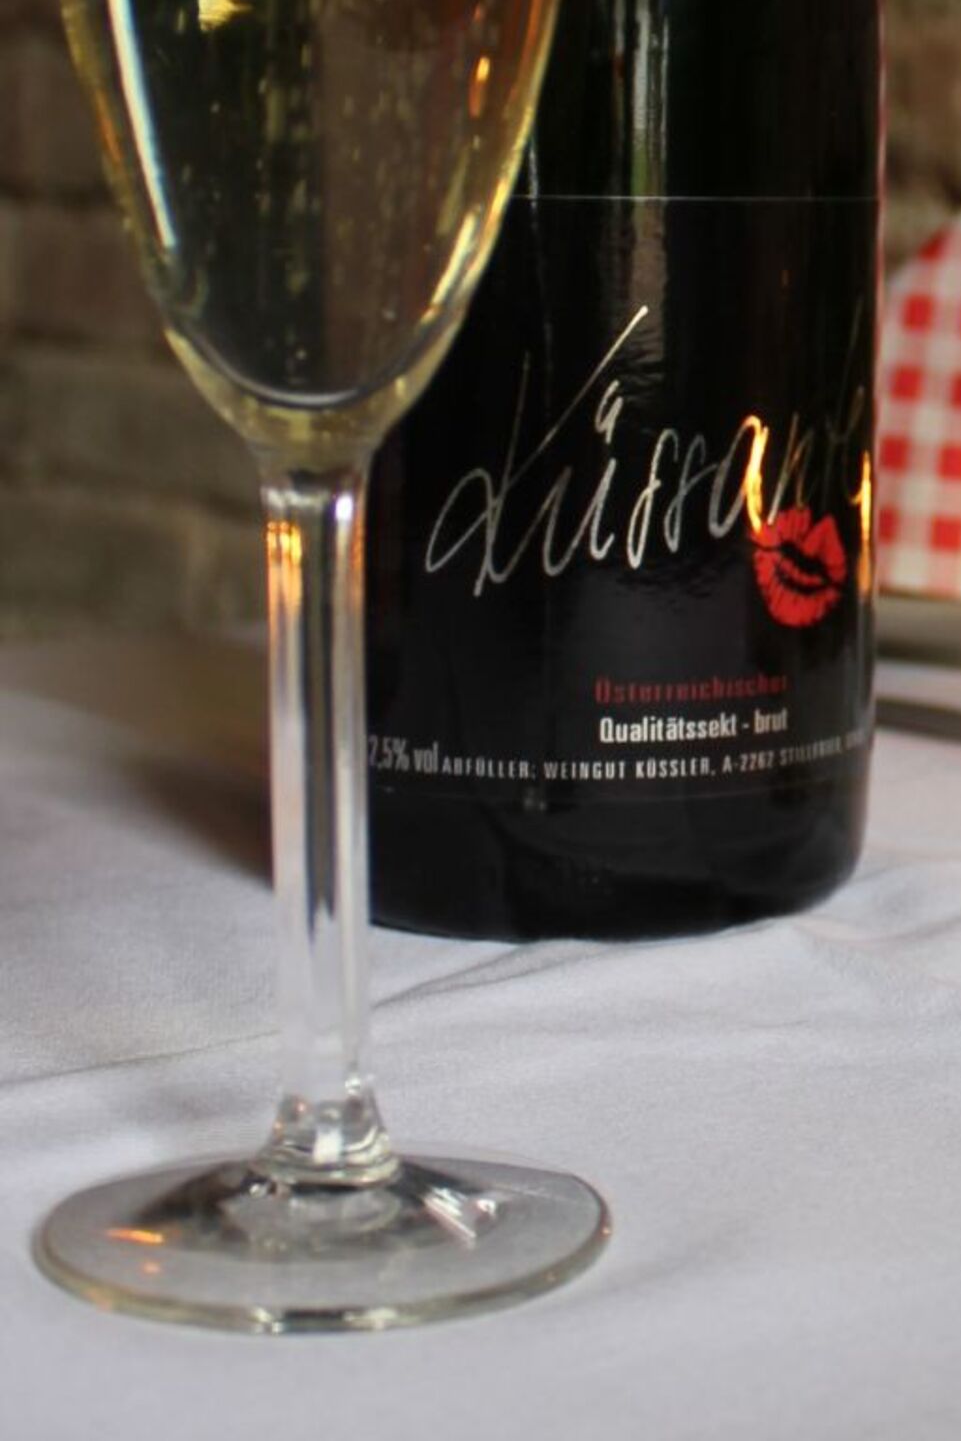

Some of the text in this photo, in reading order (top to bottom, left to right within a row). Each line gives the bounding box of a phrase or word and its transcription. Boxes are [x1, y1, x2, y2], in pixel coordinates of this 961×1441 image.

[599, 712, 738, 744] Qualitätssekt
[753, 708, 788, 734] brut
[368, 735, 439, 774] 2,5% vol
[543, 760, 626, 780] WEINGUT
